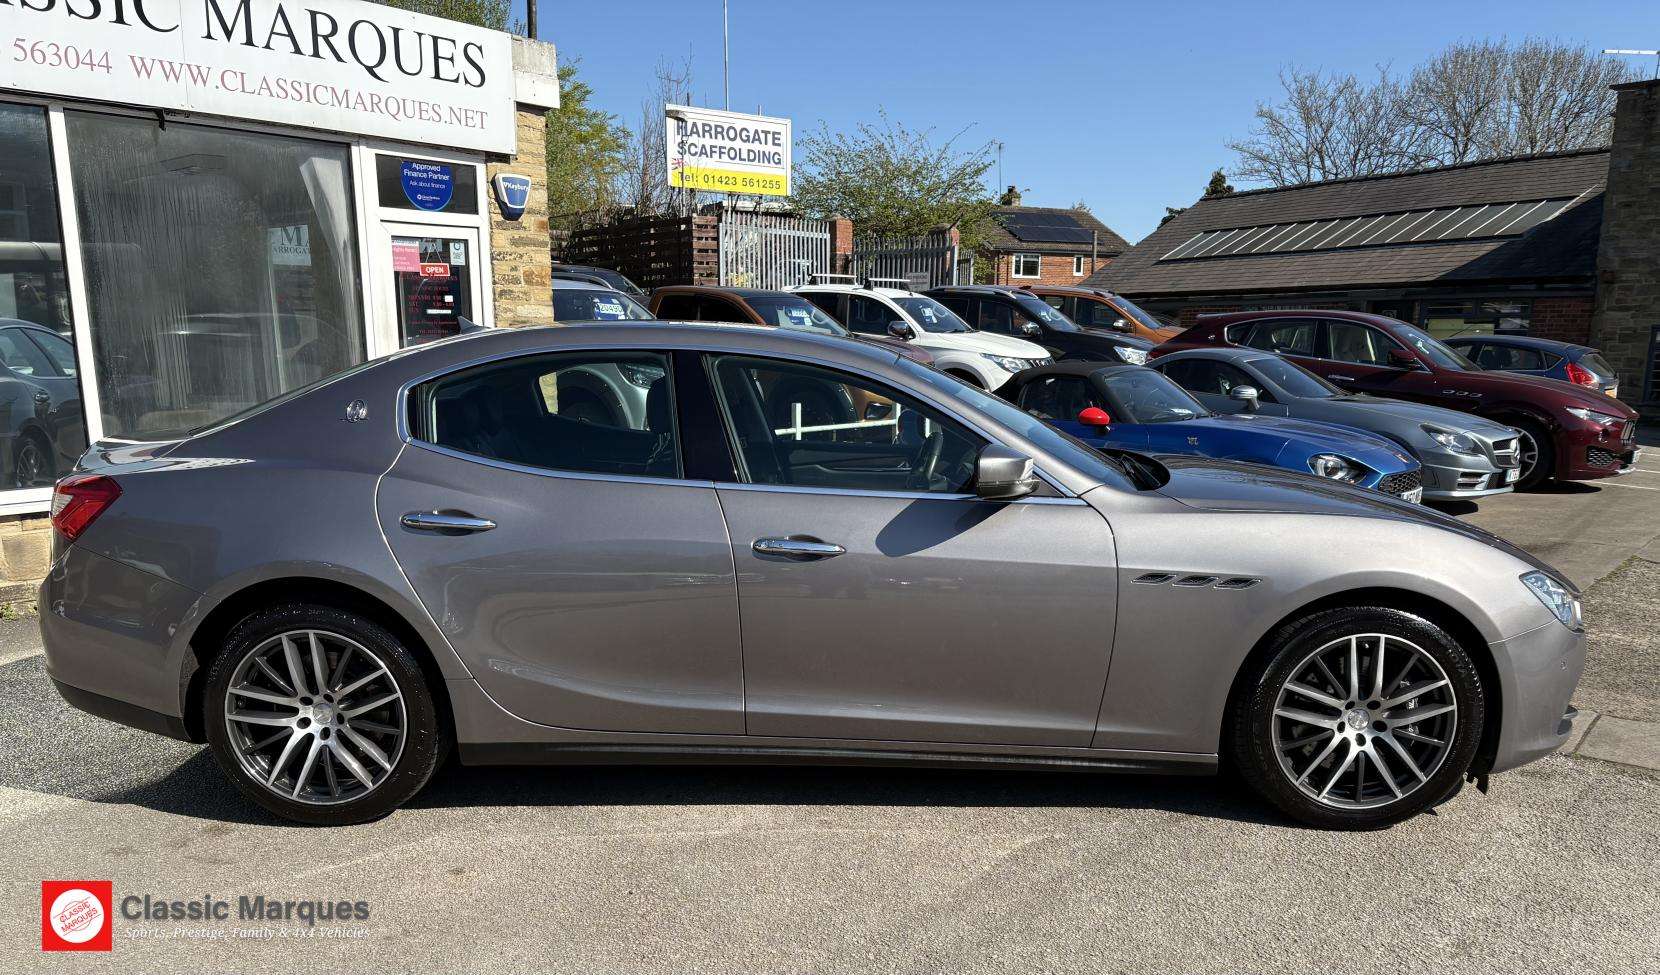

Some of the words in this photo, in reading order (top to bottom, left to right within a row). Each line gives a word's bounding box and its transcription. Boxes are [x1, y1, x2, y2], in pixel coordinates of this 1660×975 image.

[201, 0, 486, 88] MARQUES
[13, 38, 112, 74] 563044
[128, 55, 488, 130] WWW.CLASSICMARQUES.NET
[676, 120, 782, 147] HARROGATE
[677, 141, 782, 165] SCAFFOLDING
[403, 169, 428, 178] Finance
[428, 171, 450, 180] Partner
[412, 163, 440, 171] Approved
[678, 172, 698, 183] Tel:
[703, 174, 737, 186] 01423
[742, 177, 781, 189] 561255
[425, 266, 444, 275] OPEN
